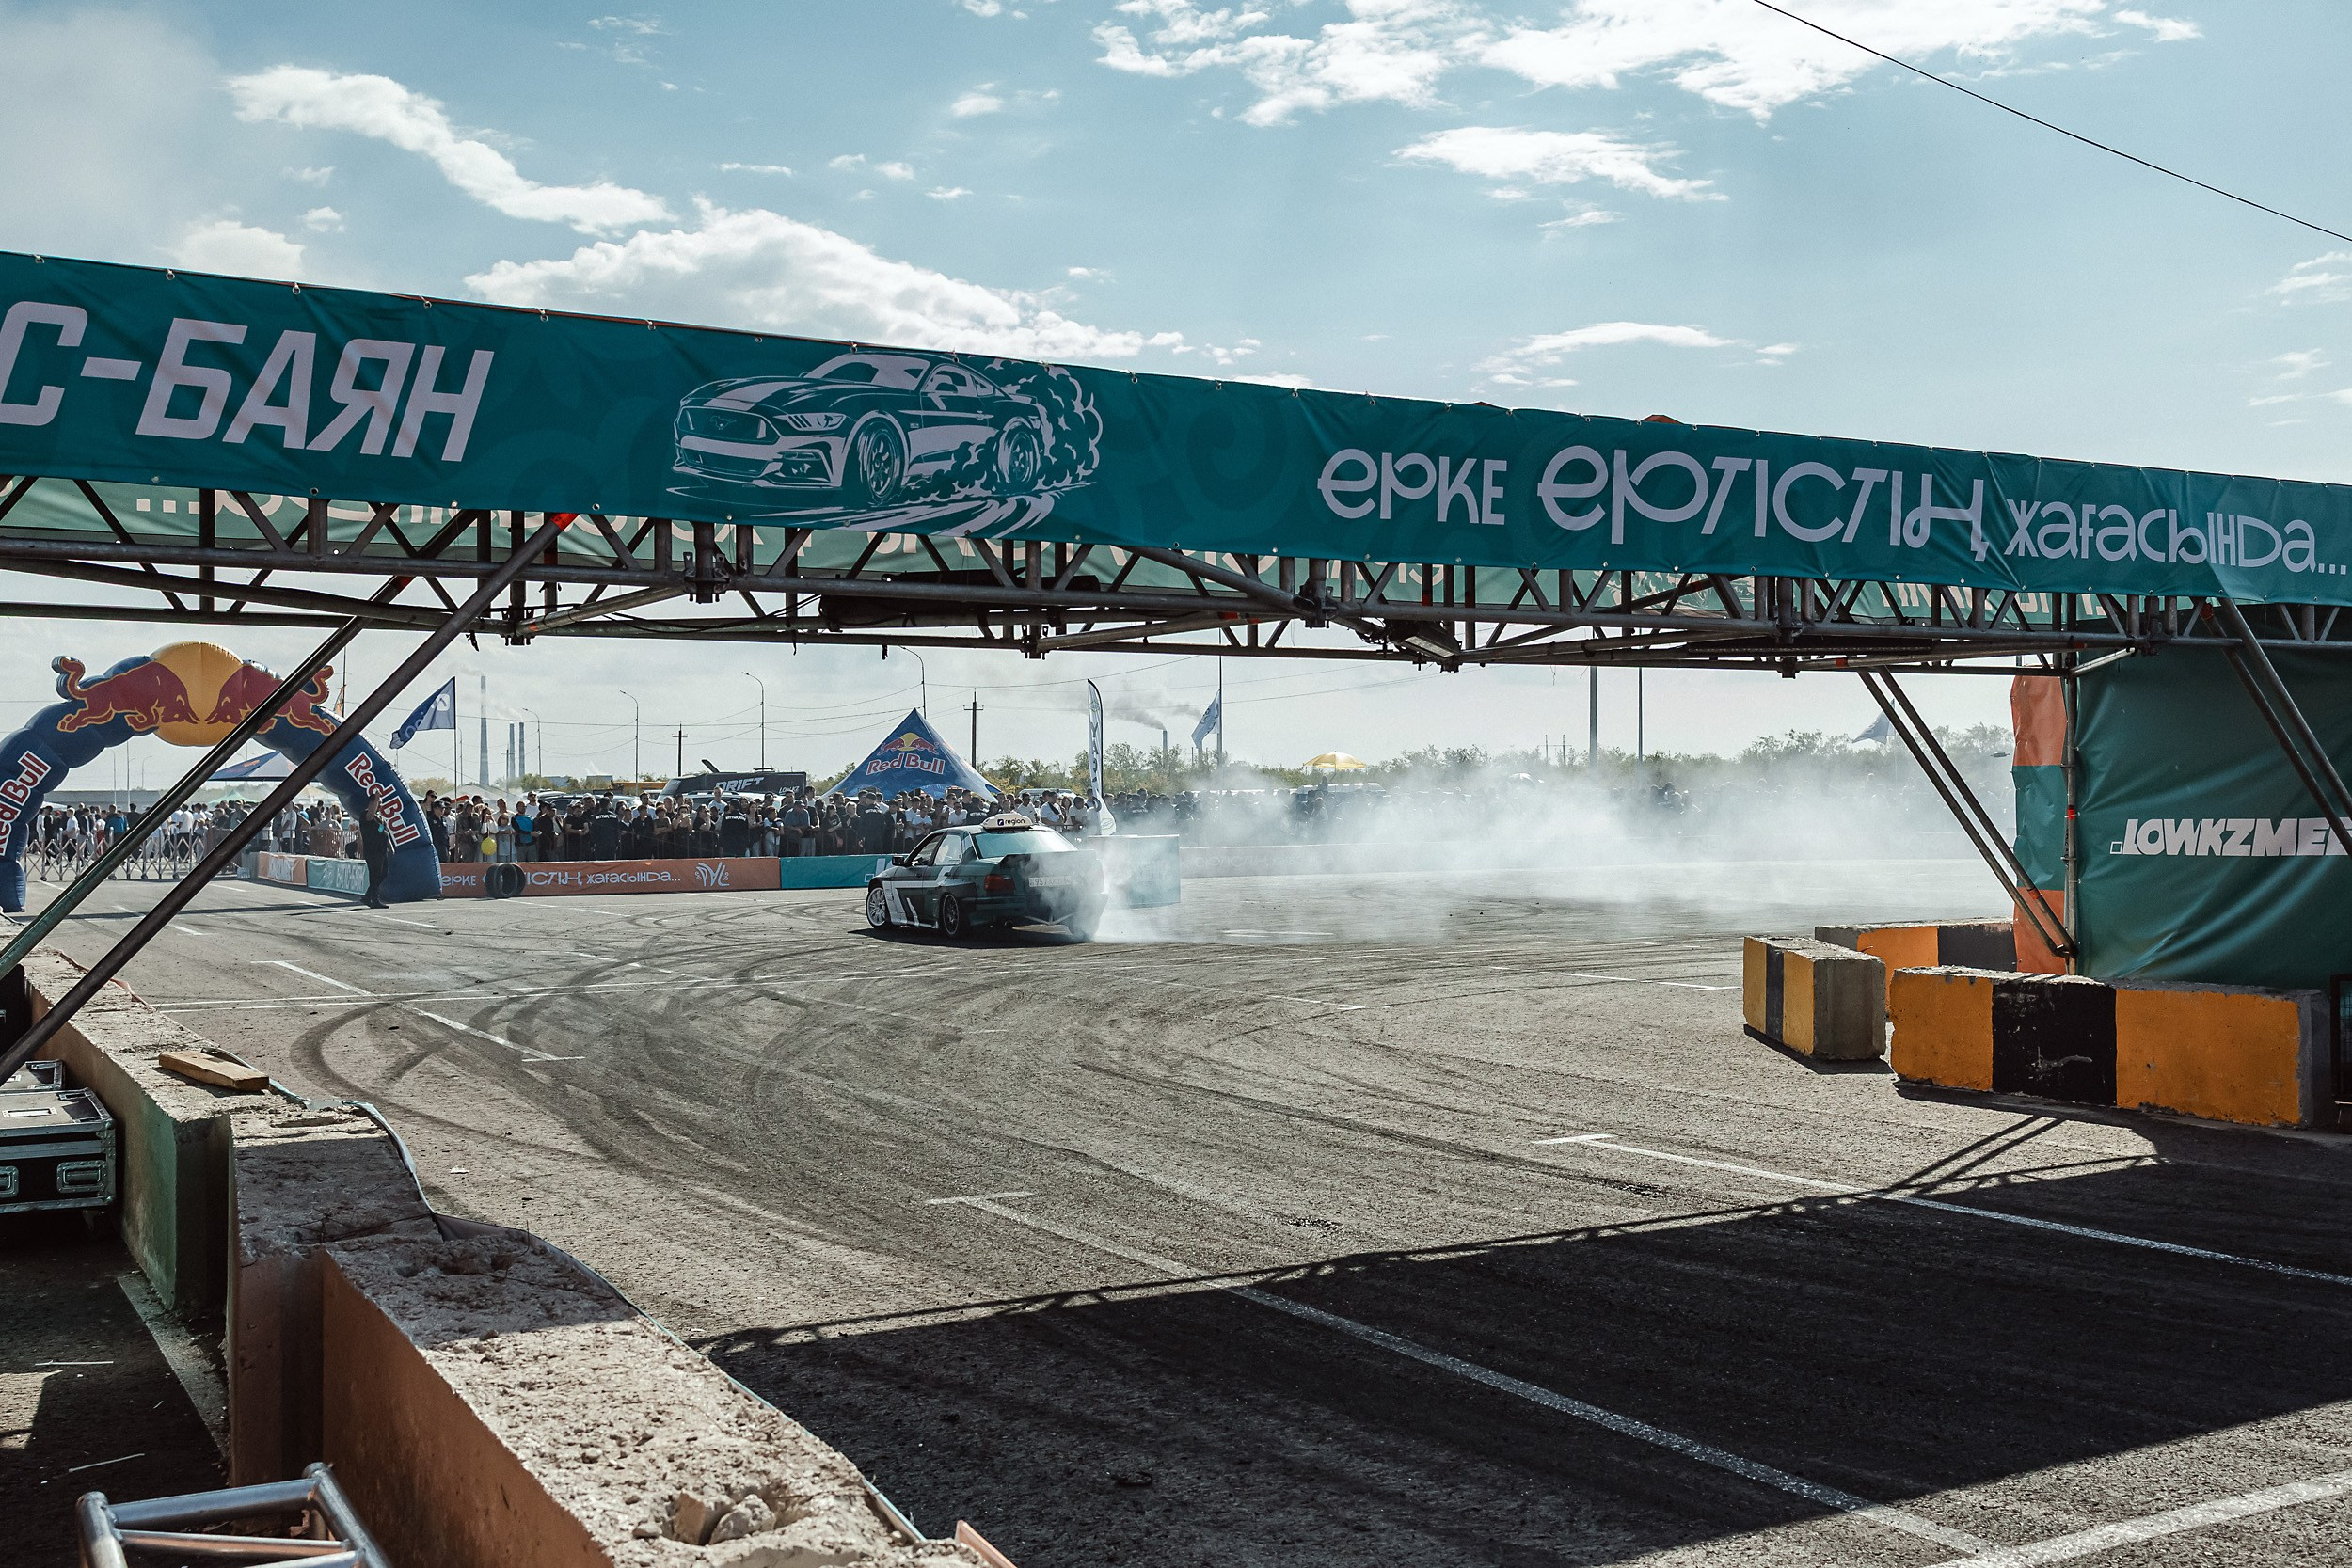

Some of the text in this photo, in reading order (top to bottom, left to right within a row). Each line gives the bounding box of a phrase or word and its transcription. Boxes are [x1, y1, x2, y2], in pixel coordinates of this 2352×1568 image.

[0, 301, 494, 462] С-БАЯН
[0, 750, 52, 856] ed Bull
[344, 751, 396, 799] Red
[378, 795, 421, 847] Bull
[715, 777, 764, 792] DRIFT
[866, 752, 945, 775] Red Bull
